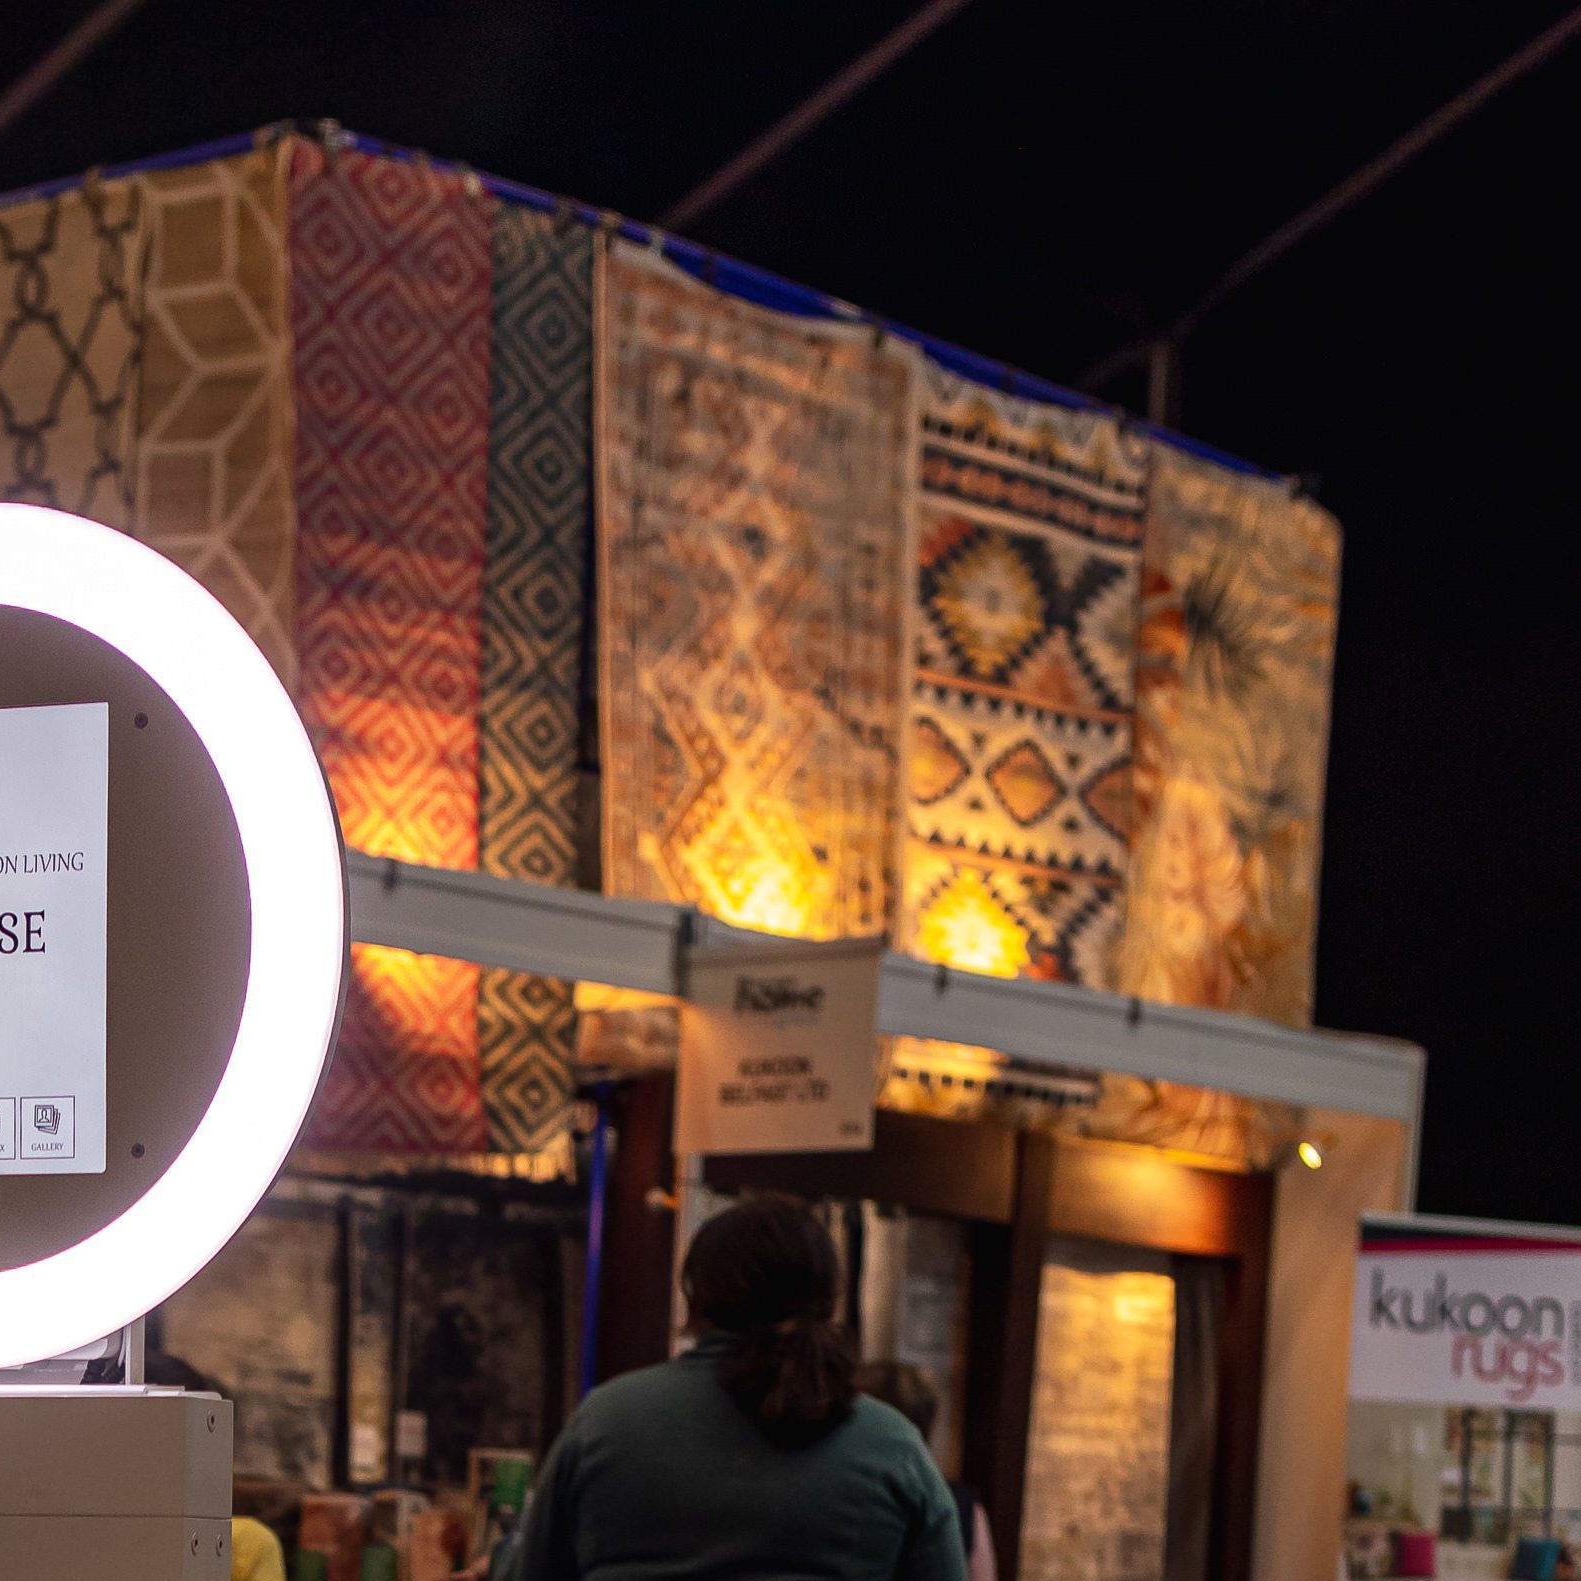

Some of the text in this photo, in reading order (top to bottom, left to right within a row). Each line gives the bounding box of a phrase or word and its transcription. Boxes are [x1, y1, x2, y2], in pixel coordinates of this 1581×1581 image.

[23, 852, 84, 874] LIVING
[31, 1142, 64, 1152] GALLERY
[1371, 1267, 1565, 1342] kukoon
[1450, 1335, 1565, 1402] rugs
